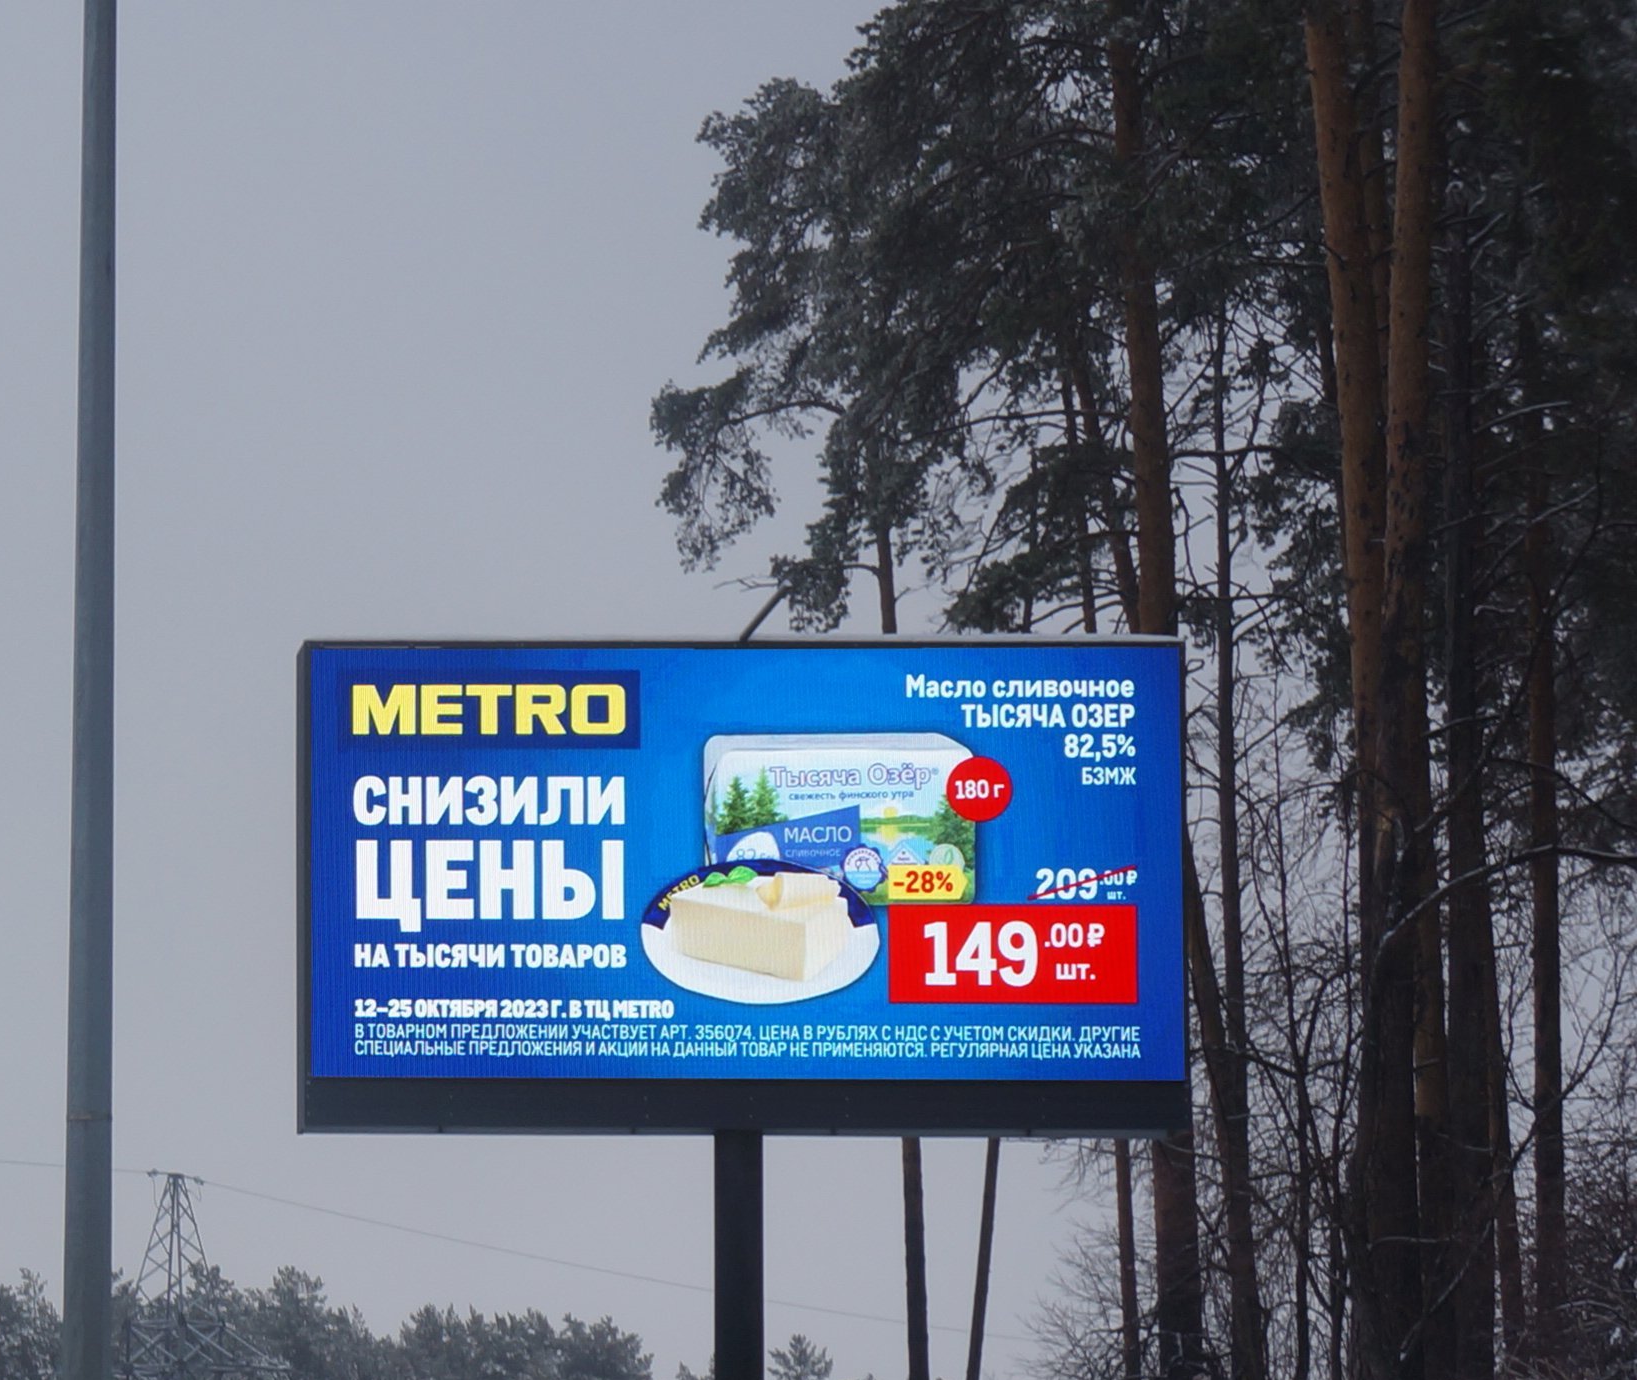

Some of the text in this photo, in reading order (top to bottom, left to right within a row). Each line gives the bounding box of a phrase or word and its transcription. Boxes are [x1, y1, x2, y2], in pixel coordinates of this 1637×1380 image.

[906, 674, 1135, 699] Масло сливочное
[352, 684, 626, 735] METRO
[961, 704, 1135, 728] ТЫСЯЧА ОЗЕР
[1064, 734, 1136, 762] 82,5%
[770, 766, 861, 788] Тысяча
[1081, 767, 1136, 786] БЗМЖ
[353, 775, 625, 826] СНИЗИЛИ
[789, 789, 915, 802] свежесть финского утра
[955, 781, 1004, 799] 180 г
[784, 826, 853, 844] МАСЛО
[356, 839, 624, 933] ЦЕНЫ
[893, 870, 954, 894] -28%
[1035, 868, 1098, 900] 209
[1107, 891, 1127, 901] шт.
[354, 943, 627, 968] НА ТЫСЯЧИ ТОВАРОВ
[923, 920, 1039, 987] 149
[1055, 963, 1097, 981] шт.
[354, 998, 675, 1022] 12–25 ОКТЯБРЯ 2023 Г. В ТЦ METRO
[354, 1023, 365, 1039] В
[368, 1023, 447, 1040] ТОВАРНОМ
[451, 1024, 569, 1041] ПРЕДЛОЖЕНИИ
[571, 1024, 657, 1041] УЧАСТВУЕТ
[660, 1025, 692, 1041] АРТ.
[760, 1025, 800, 1042] ЦЕНА
[803, 1025, 814, 1041] В
[817, 1025, 878, 1041] РУБЛЯХ
[881, 1025, 892, 1041] С
[895, 1025, 928, 1042] НДС
[930, 1025, 941, 1042] С
[943, 1025, 1004, 1042] УЧЕТОМ
[1007, 1026, 1076, 1042] СКИДКИ.
[1079, 1026, 1141, 1042] ДРУГИЕ
[354, 1038, 1142, 1060] СПЕЦИАЛЬНЫЕ ПРЕДЛОЖЕНИЯ И АКЦИИ НА ДАННЫЙ ТОВАР НЕ ПРИМЕНЯЮТСЯ. РЕГУЛЯРНАЯ ЦЕНА УКАЗАНА
